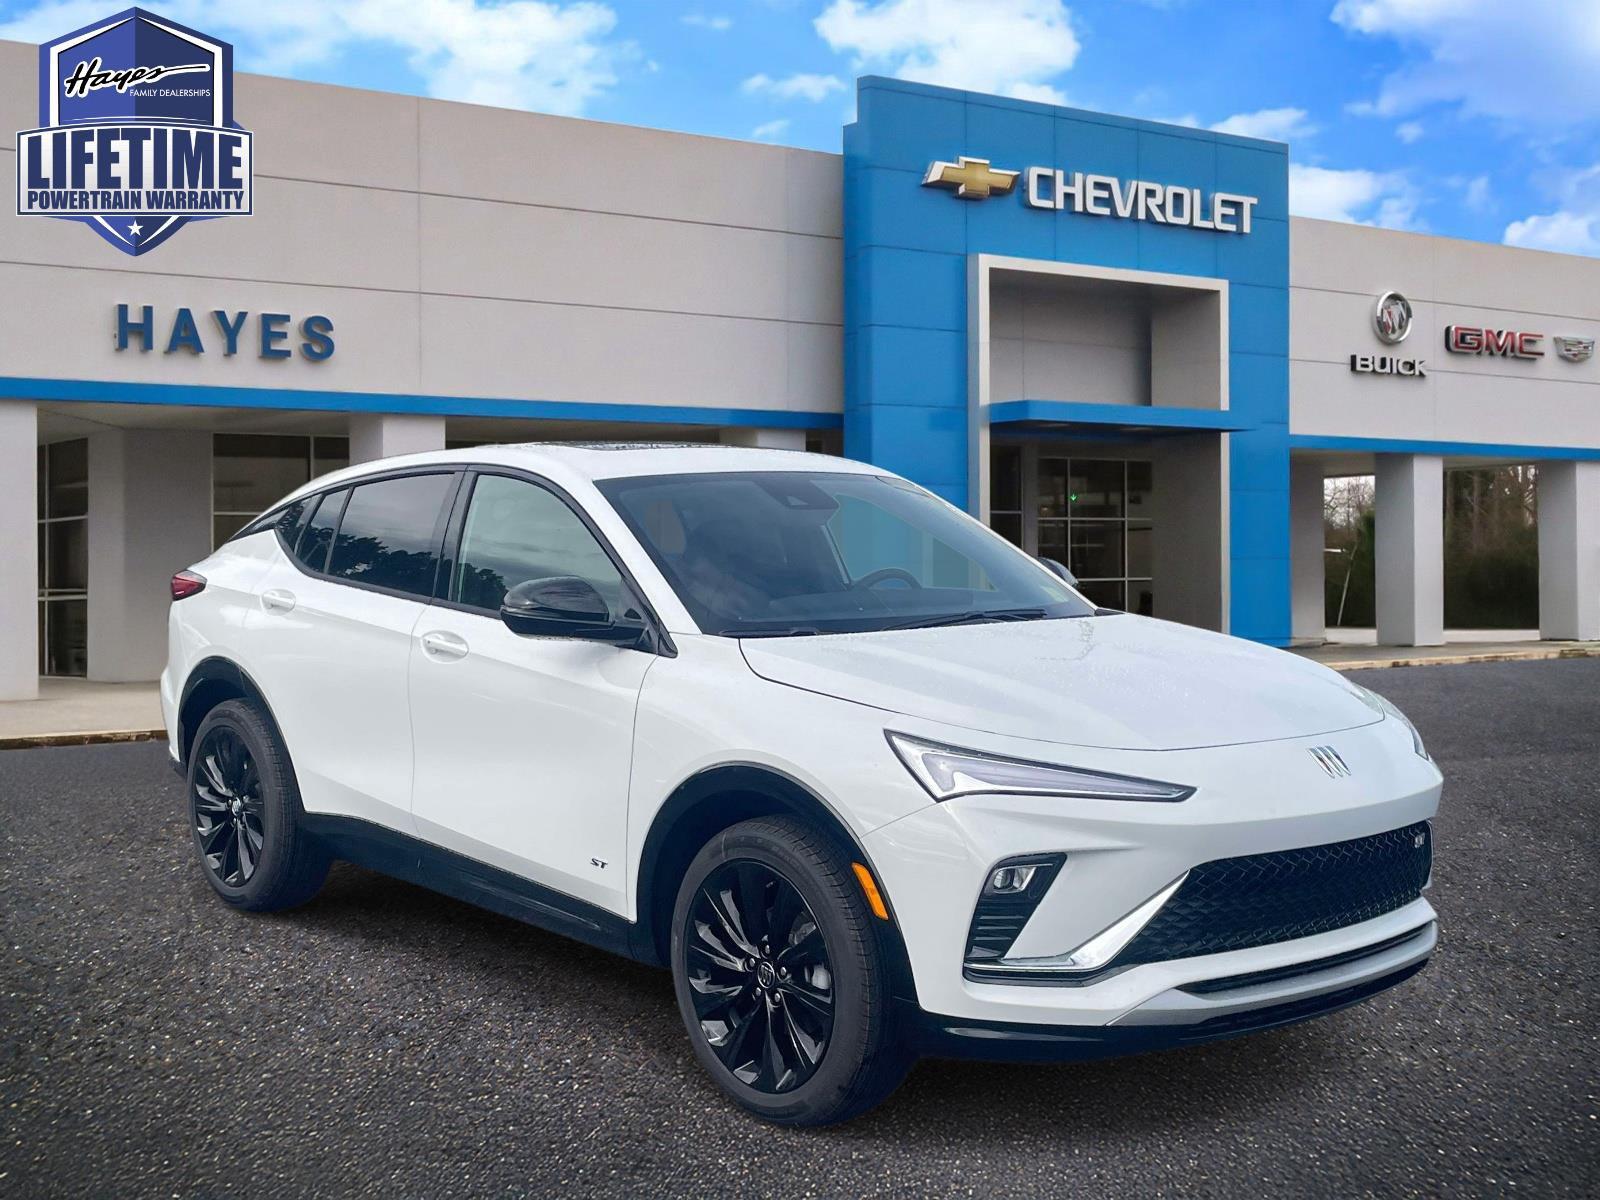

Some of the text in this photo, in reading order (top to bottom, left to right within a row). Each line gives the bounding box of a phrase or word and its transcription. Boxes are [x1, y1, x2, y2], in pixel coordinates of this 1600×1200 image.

[1025, 166, 1259, 234] CHEVROLET
[115, 303, 336, 362] HAYES
[1445, 325, 1546, 360] GMC
[1350, 354, 1428, 377] BUICK
